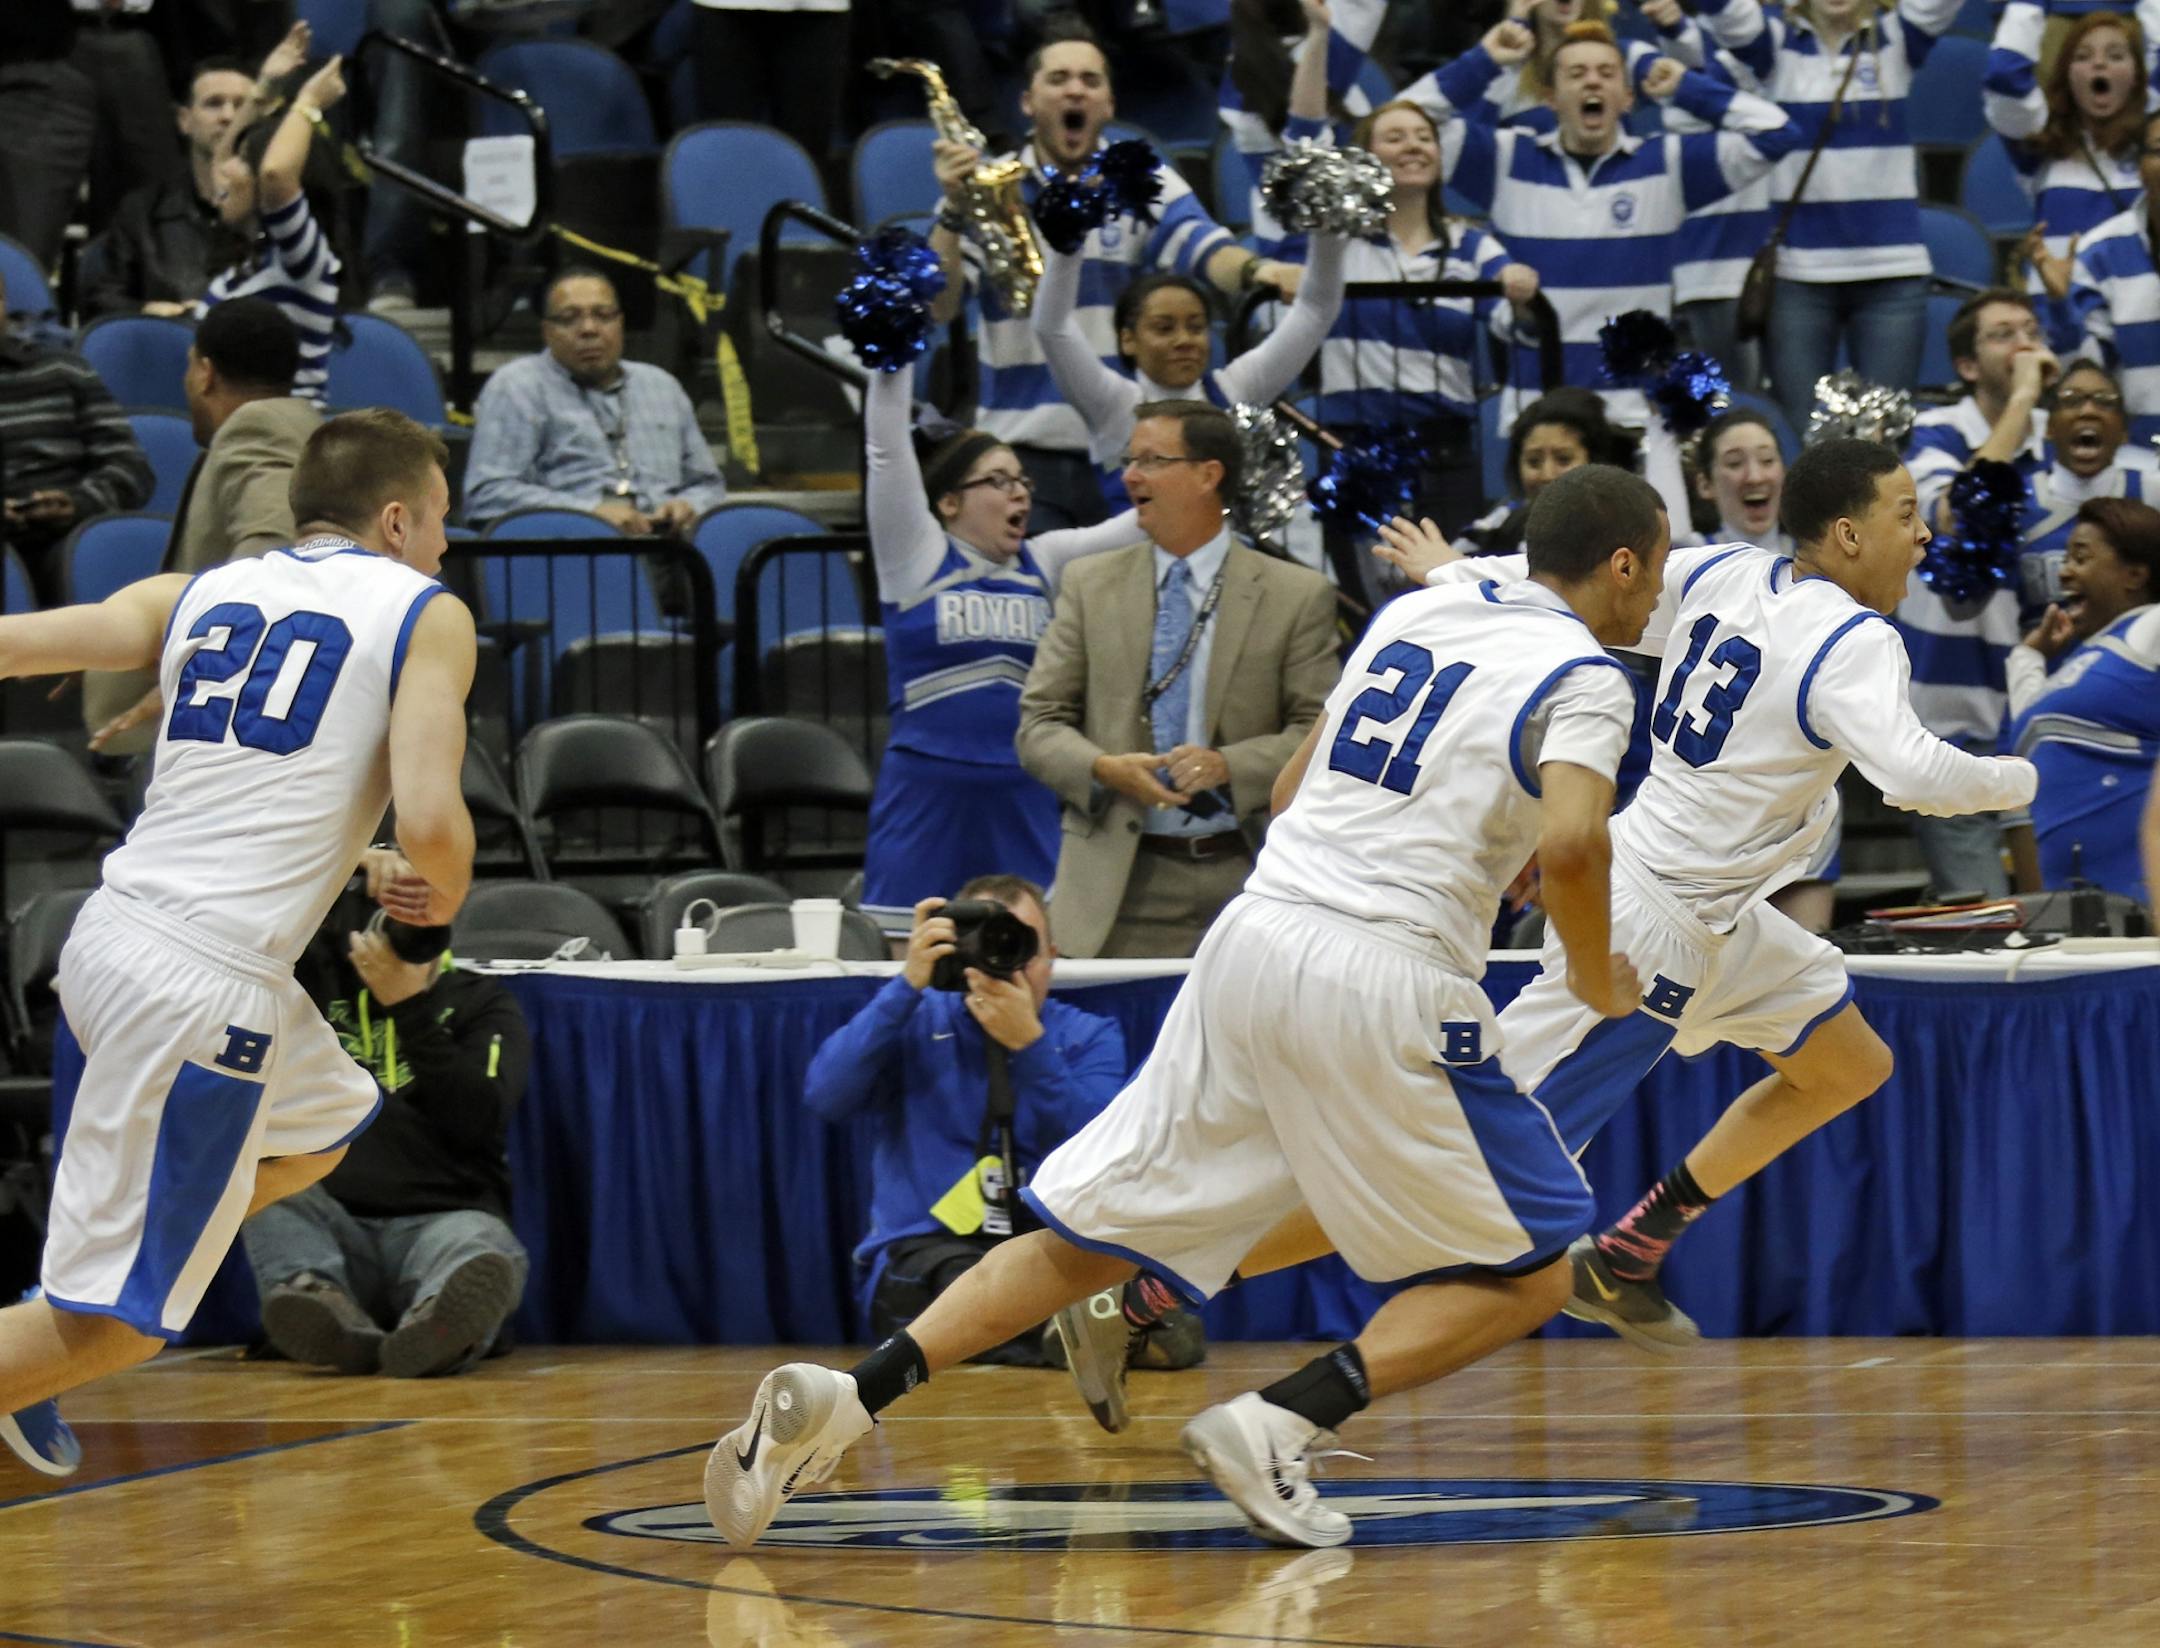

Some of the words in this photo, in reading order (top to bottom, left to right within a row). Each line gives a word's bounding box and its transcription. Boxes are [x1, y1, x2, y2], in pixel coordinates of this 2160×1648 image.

[167, 602, 355, 756] 20
[1328, 639, 1477, 796] 21
[1651, 613, 1762, 769] 13
[1440, 1021, 1482, 1062] B
[1642, 972, 1696, 1019] B
[214, 1024, 273, 1074] B
